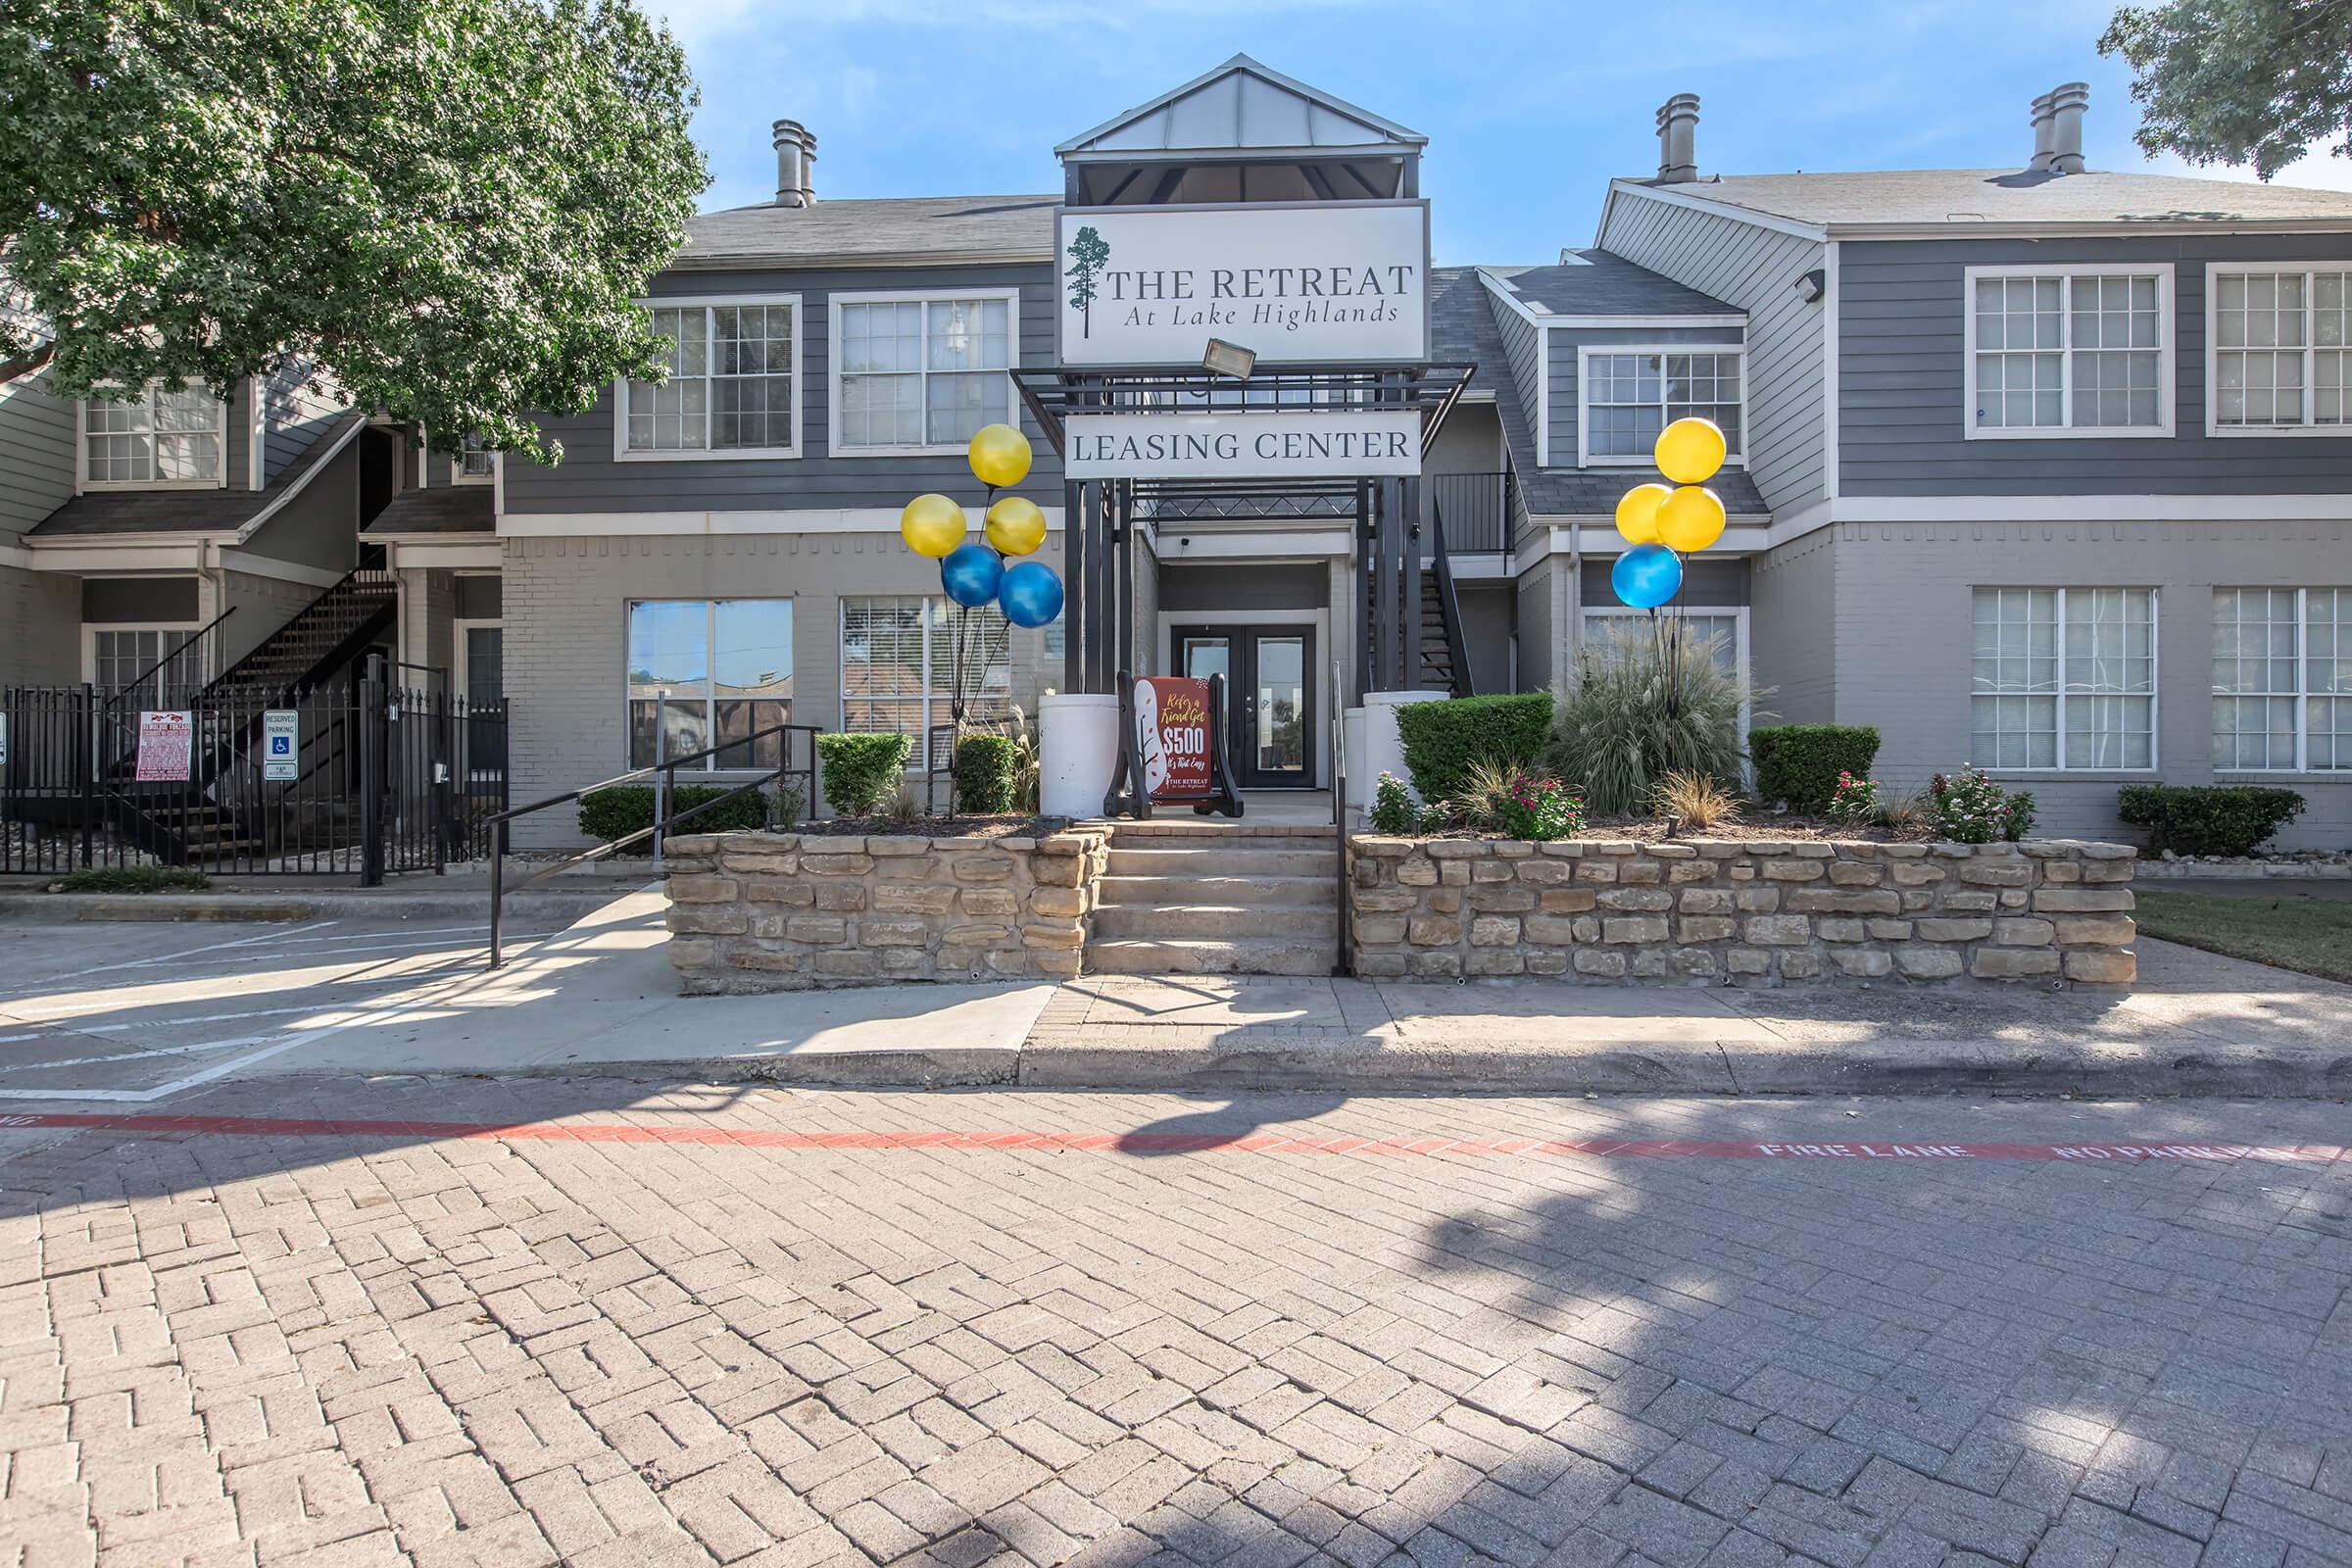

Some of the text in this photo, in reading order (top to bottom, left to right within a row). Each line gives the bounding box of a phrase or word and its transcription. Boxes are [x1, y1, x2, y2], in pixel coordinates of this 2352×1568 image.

[1106, 266, 1413, 301] THE RETREAT
[1123, 299, 1398, 331] At Lake Highlands
[1073, 431, 1410, 462] LEASING CENTER
[1190, 708, 1205, 727] Get
[1163, 726, 1204, 756] $500
[1755, 1145, 1976, 1158] FIRE LANE
[2051, 1147, 2112, 1158] NO
